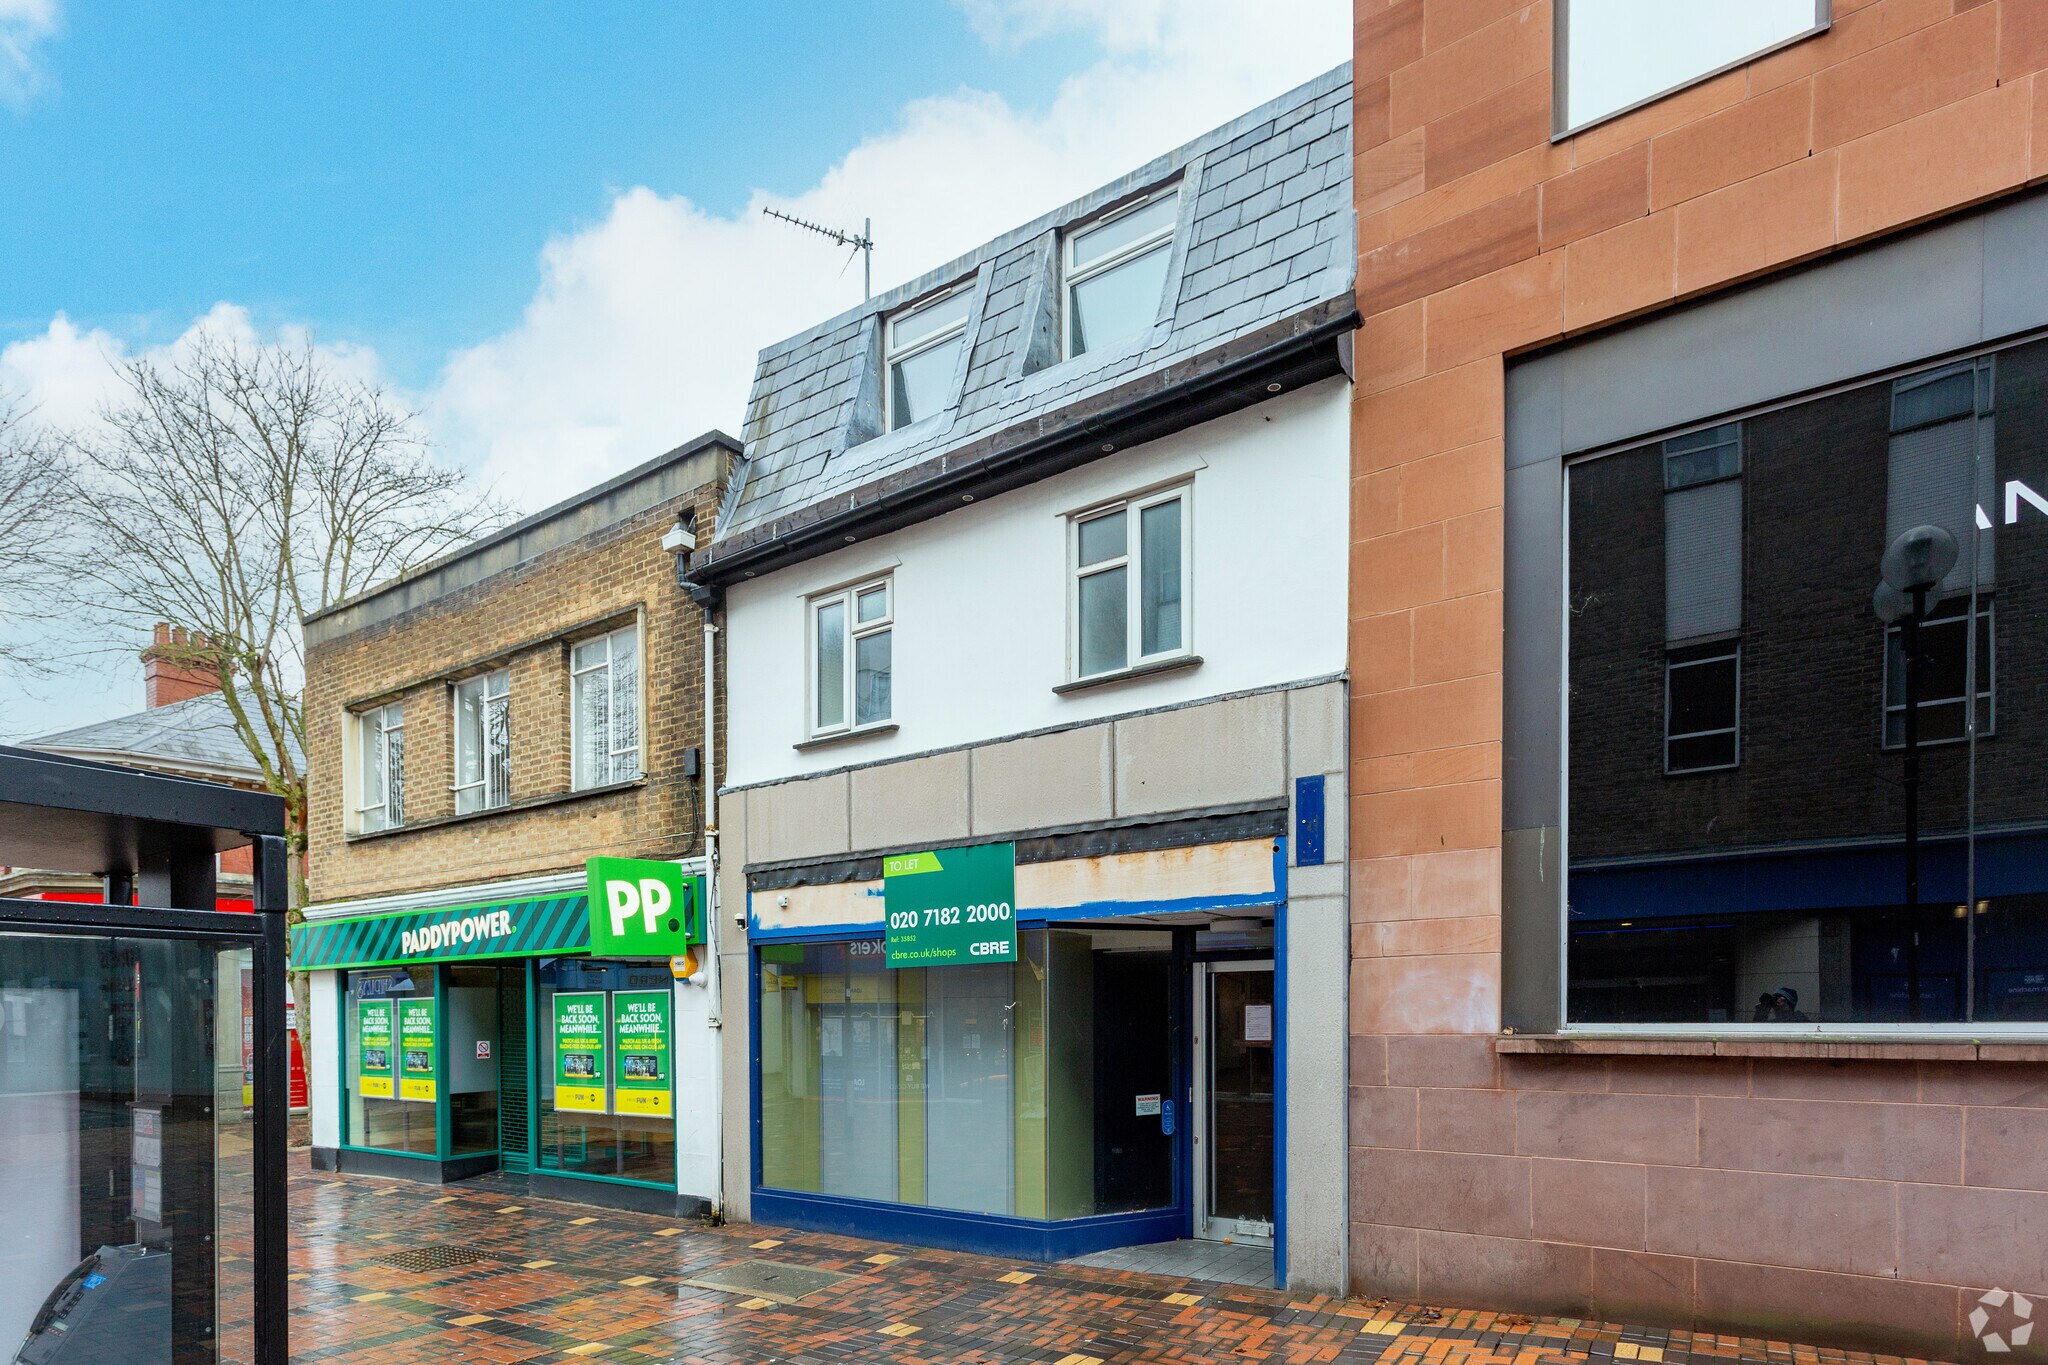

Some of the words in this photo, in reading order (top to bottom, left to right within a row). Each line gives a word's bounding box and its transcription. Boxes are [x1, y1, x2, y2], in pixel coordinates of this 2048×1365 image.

[889, 860, 902, 872] TO
[904, 858, 919, 870] LET
[890, 911, 918, 929] 020
[923, 906, 960, 927] 7182
[966, 902, 1010, 923] 2000
[891, 947, 957, 960] cbre.co.uk/shops
[969, 940, 1010, 956] CBRE
[567, 1005, 584, 1014] WE'LL
[585, 1004, 593, 1013] BE
[627, 1003, 646, 1013] WE'LL
[648, 1003, 656, 1012] BE
[561, 1014, 578, 1024] BACK
[578, 1014, 600, 1024] SOON,
[621, 1013, 639, 1023] BACK
[640, 1013, 662, 1023] SOON,
